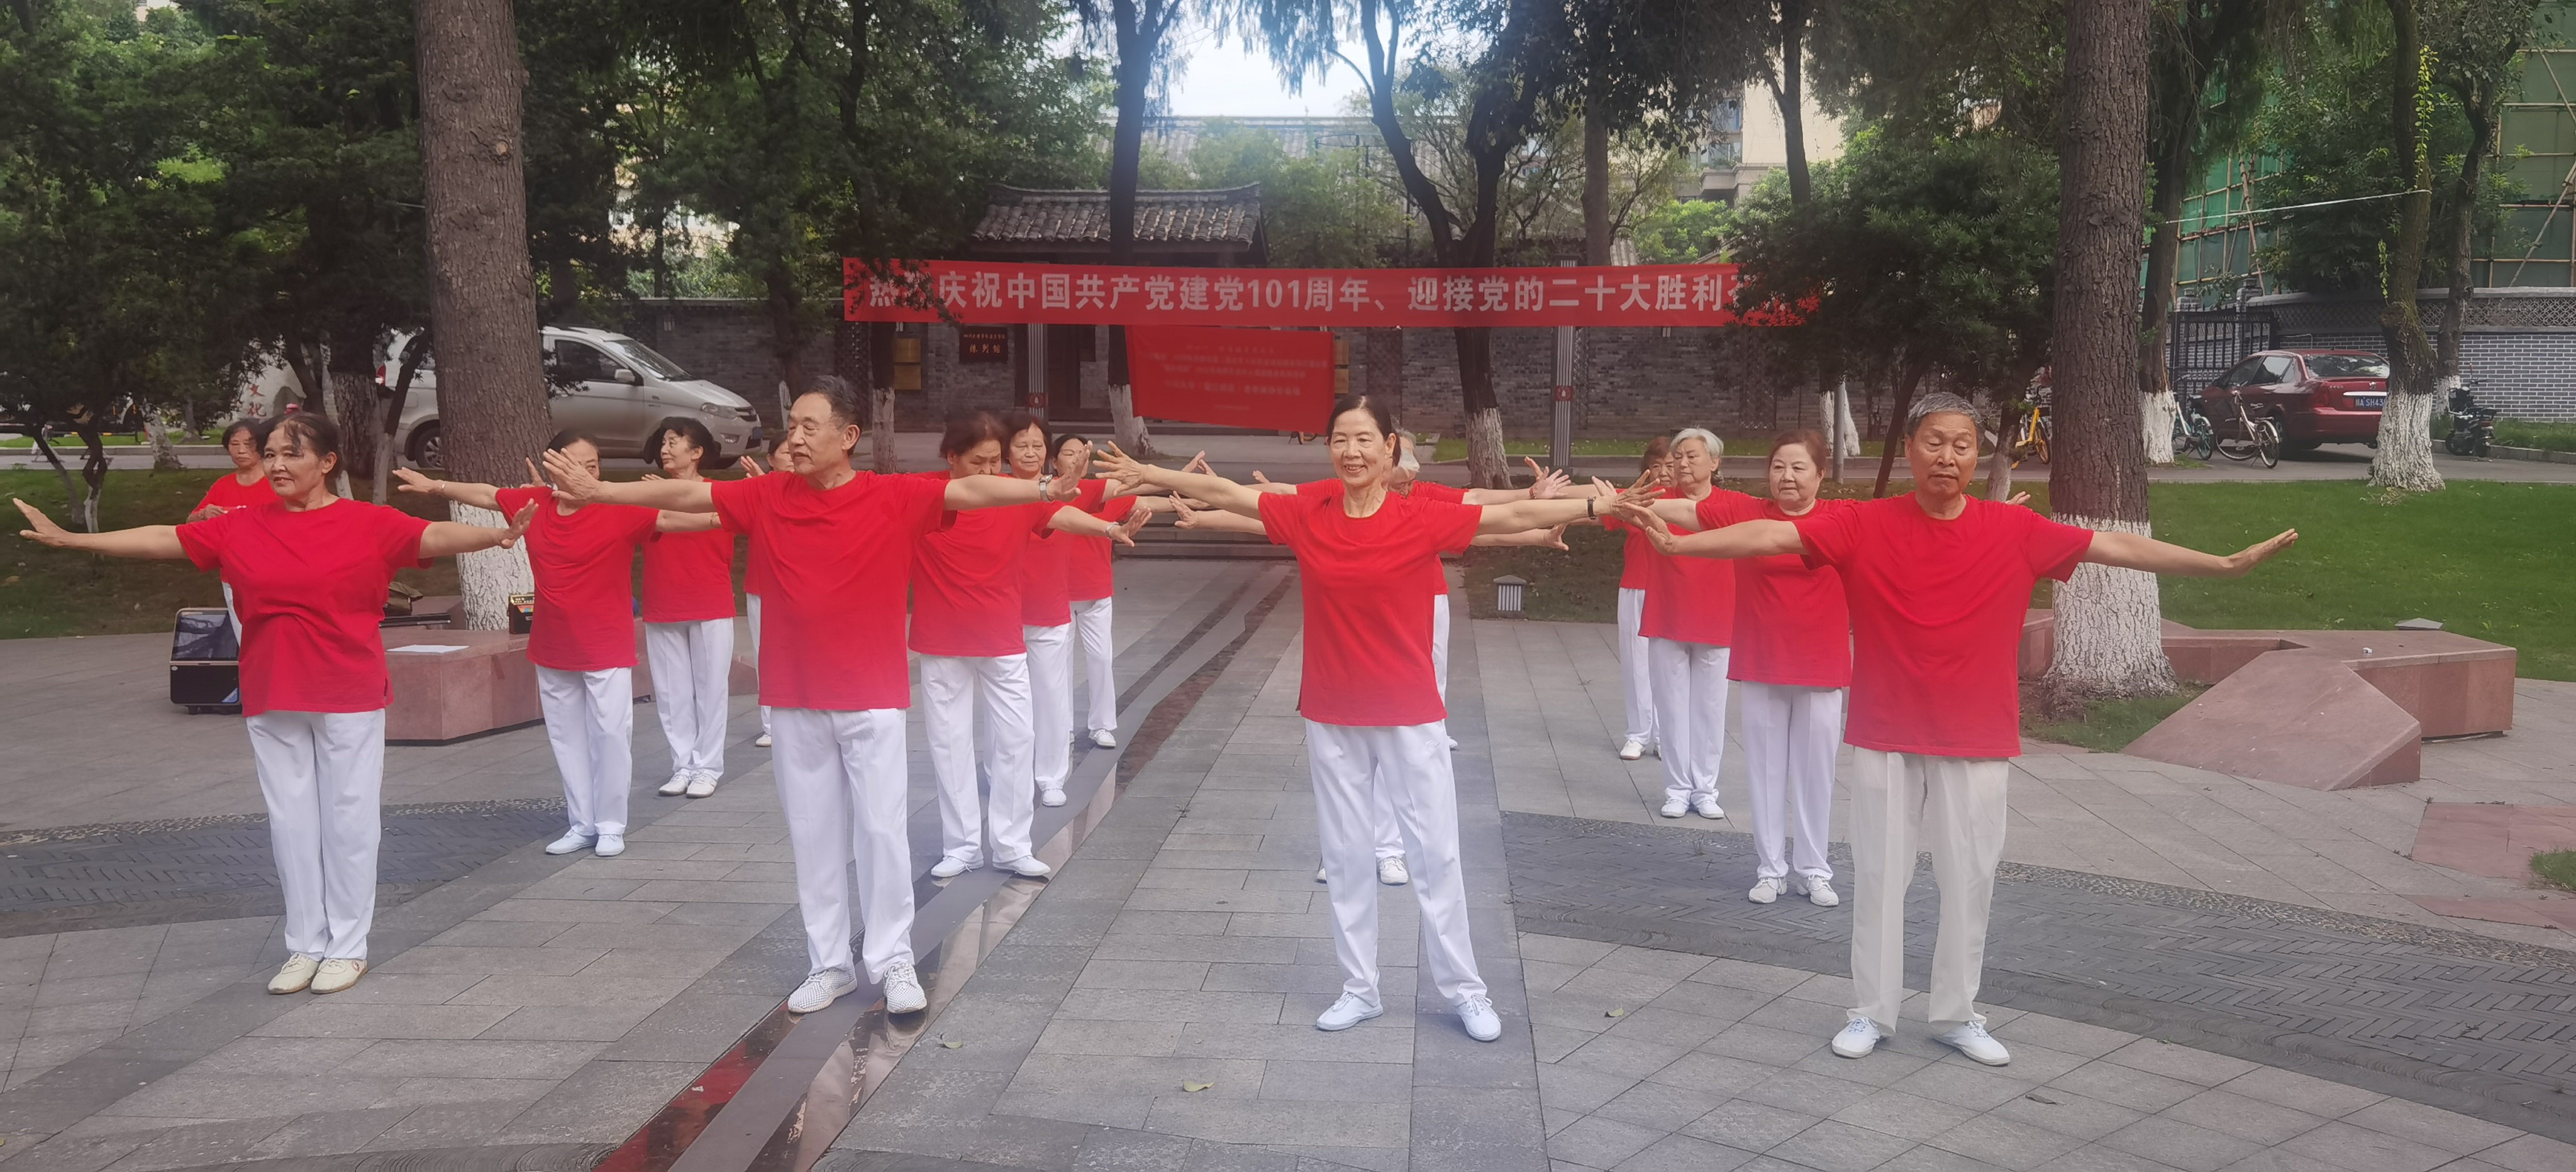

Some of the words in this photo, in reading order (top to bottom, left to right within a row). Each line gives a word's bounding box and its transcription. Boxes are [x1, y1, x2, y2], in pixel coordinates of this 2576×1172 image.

[869, 270, 1787, 313] 热庆祝中国共产党建党101周年、迎接党的二十大胜利
